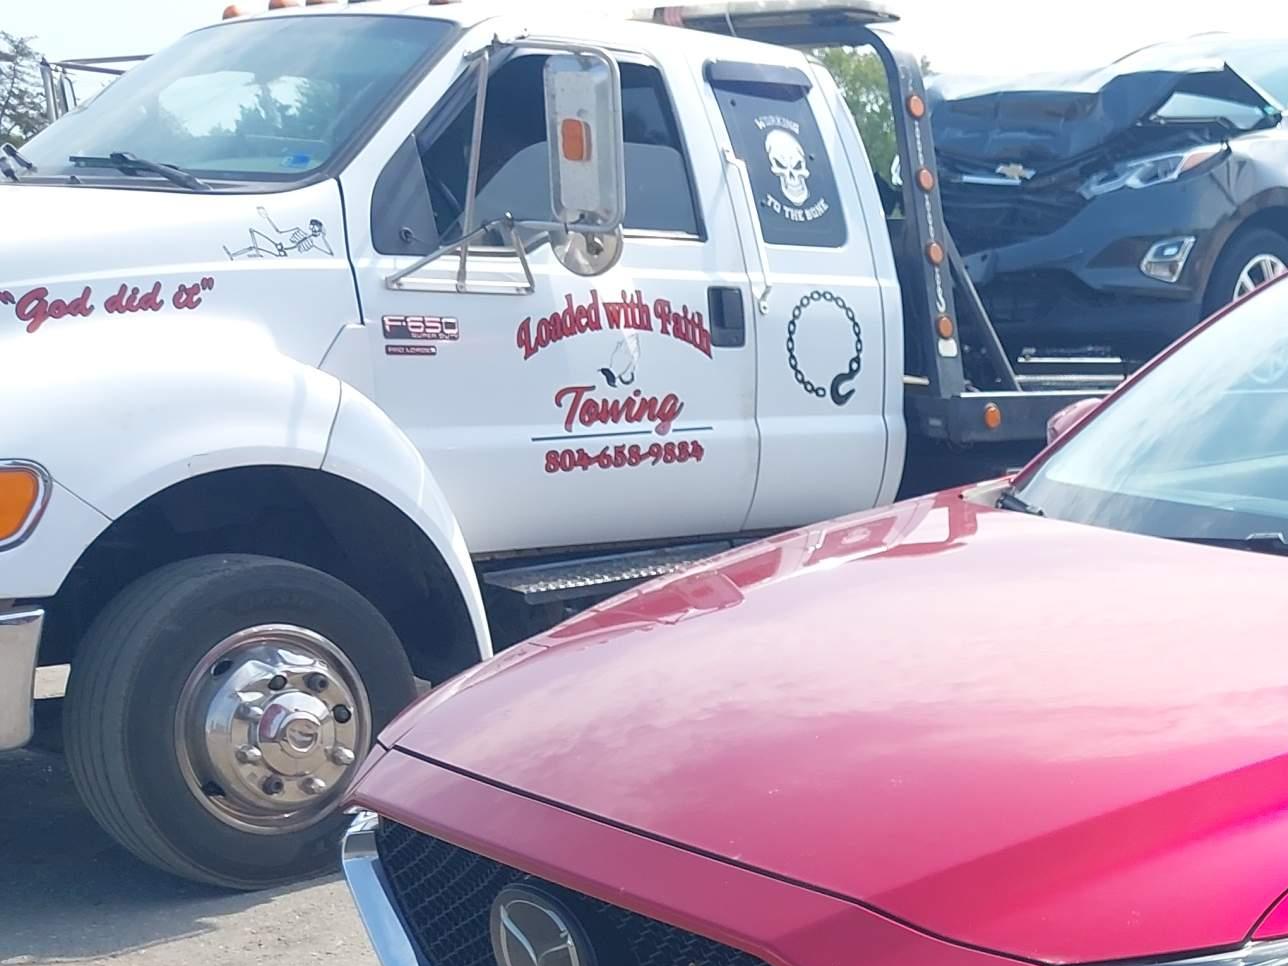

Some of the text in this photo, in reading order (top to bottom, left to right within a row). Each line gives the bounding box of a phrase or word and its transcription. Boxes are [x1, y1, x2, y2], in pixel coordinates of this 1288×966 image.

[766, 193, 830, 222] TO THE BONE
[103, 282, 165, 314] did
[516, 289, 714, 360] Loaded with Faith
[555, 385, 684, 436] Towing
[545, 439, 705, 473] 804-658-9884
